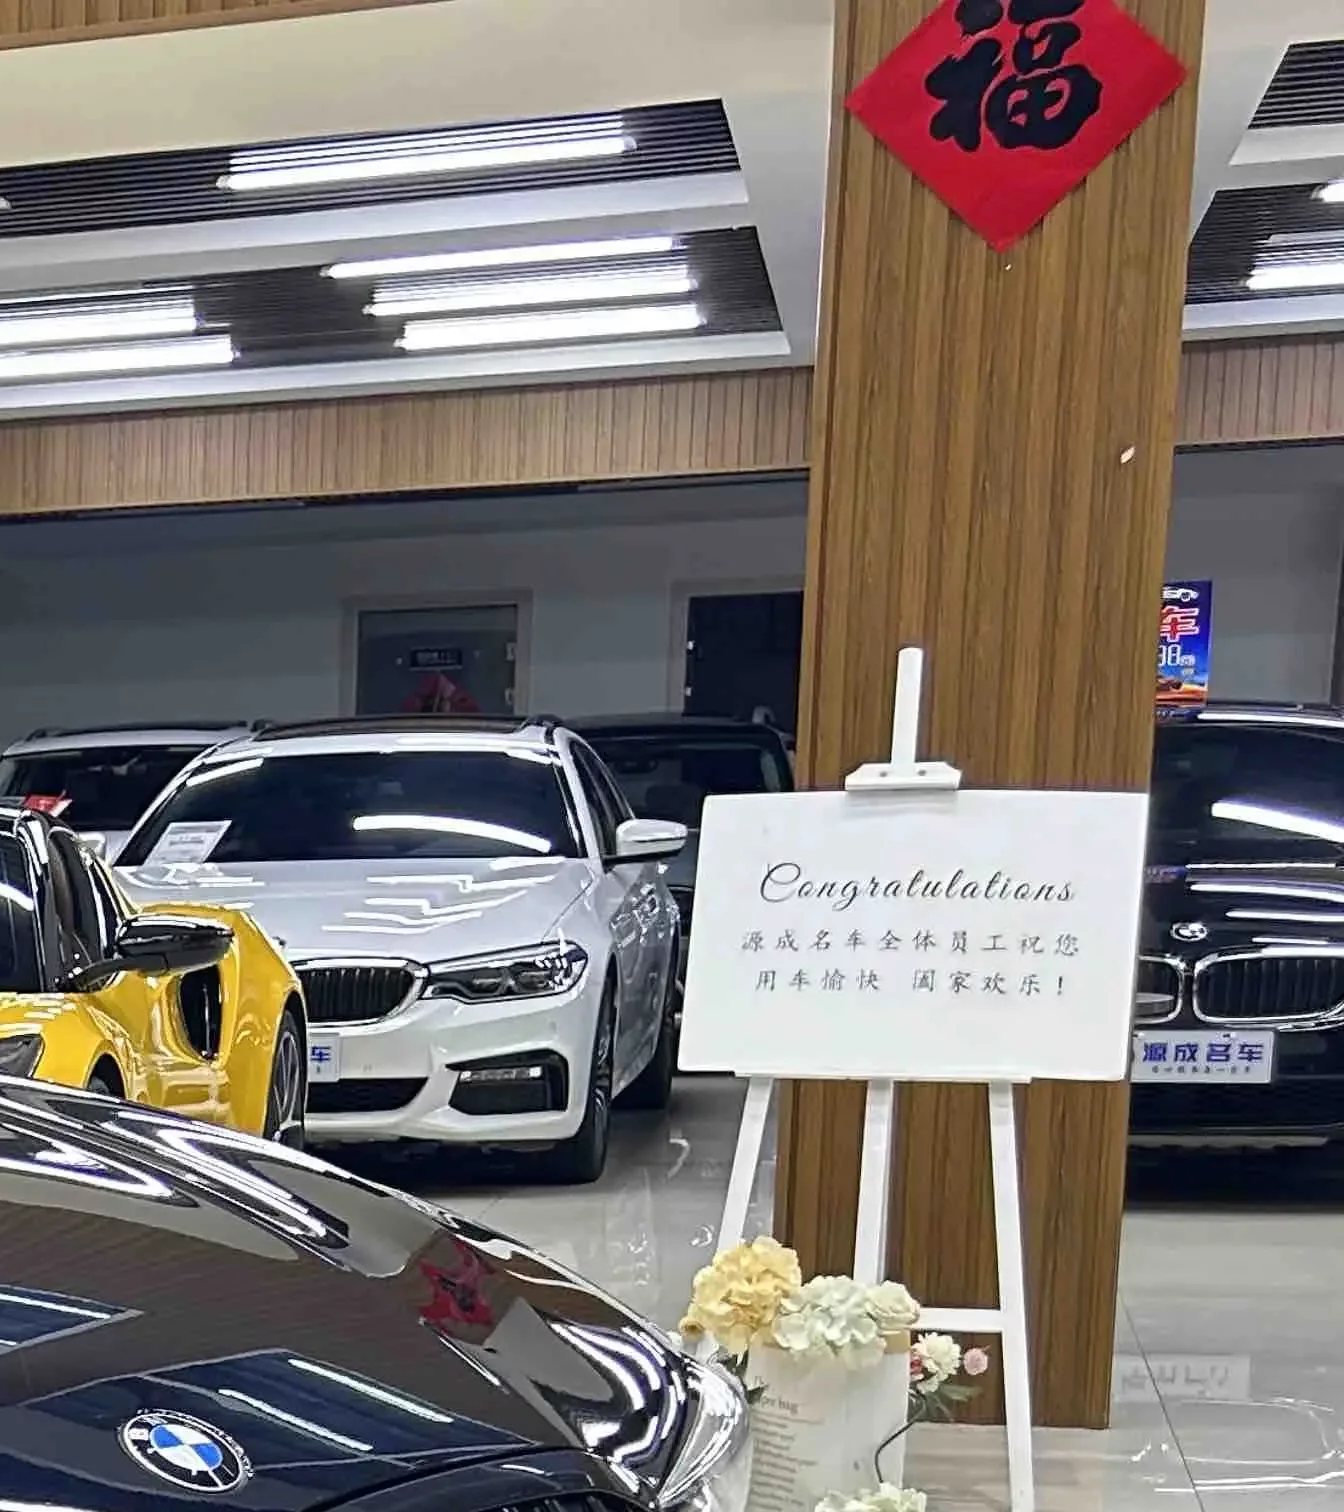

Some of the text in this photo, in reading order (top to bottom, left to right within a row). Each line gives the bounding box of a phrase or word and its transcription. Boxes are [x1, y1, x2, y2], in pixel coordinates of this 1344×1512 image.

[924, 0, 1103, 152] 福
[761, 861, 1075, 912] Congratulations
[755, 968, 882, 992] 用车愉快
[1142, 1041, 1264, 1063] 源成名车
